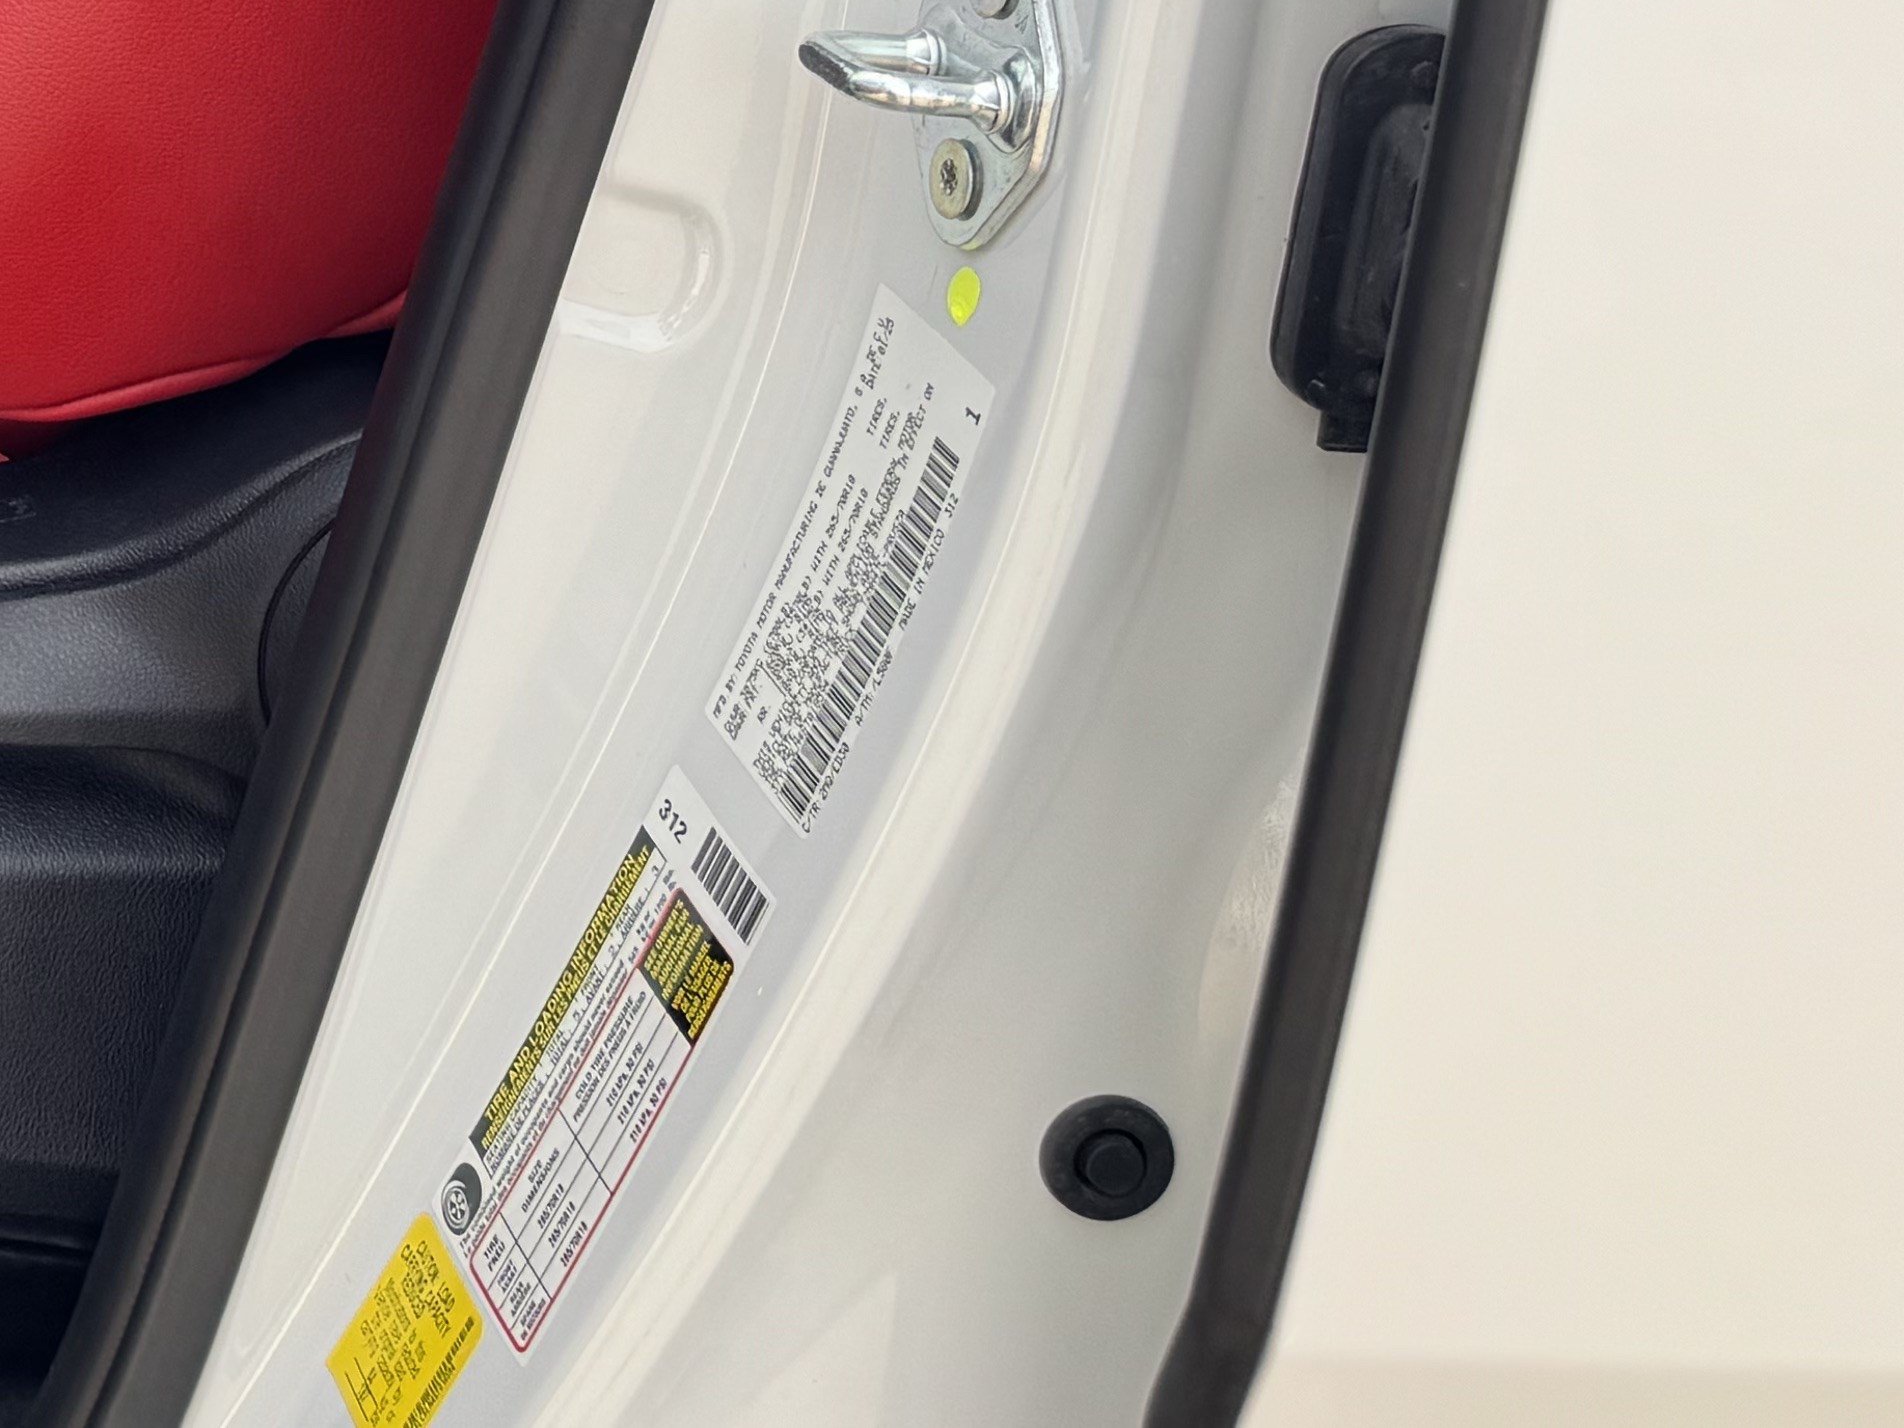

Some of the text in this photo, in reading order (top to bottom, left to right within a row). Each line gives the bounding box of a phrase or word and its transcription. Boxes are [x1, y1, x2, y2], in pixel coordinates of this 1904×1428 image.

[963, 402, 982, 427] 1
[920, 526, 946, 576] MEXICO
[734, 626, 758, 676] TOYOTA
[756, 588, 776, 631] MOTOR
[656, 795, 689, 845] 312
[484, 851, 636, 1125] TIRE AND LOADING INFORMATION
[481, 1043, 541, 1152] RENSEIGNEMENTS
